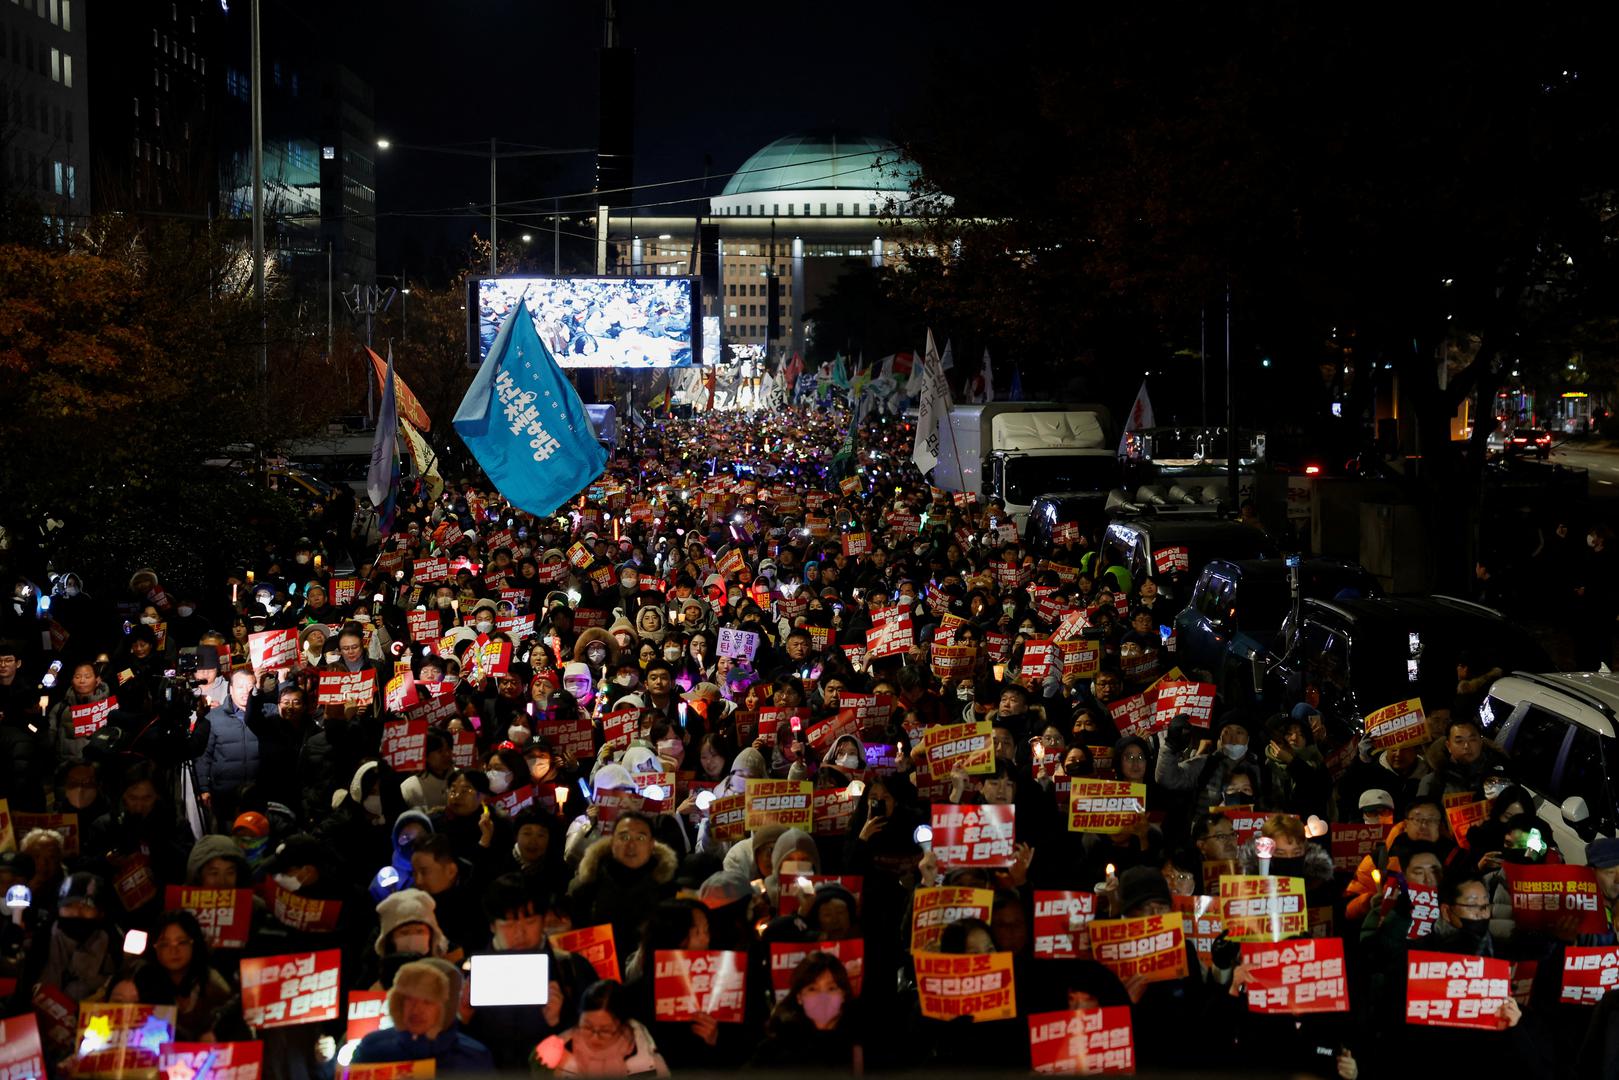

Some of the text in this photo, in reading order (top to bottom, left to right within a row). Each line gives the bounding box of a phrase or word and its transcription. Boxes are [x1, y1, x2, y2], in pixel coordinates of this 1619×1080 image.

[496, 366, 561, 462] 천촛불행동
[413, 620, 438, 632] 윤석열
[497, 615, 526, 628] 내란수괴
[812, 635, 828, 645] 석열
[934, 656, 970, 666] 국민의힘
[320, 668, 362, 685] 내란수괴
[840, 695, 877, 708] 내란수괴
[1158, 683, 1200, 699] 내란수괴
[72, 698, 109, 718] 내란수괴
[1110, 694, 1146, 719] 내란수괴
[1174, 696, 1213, 708] 윤석열
[1365, 701, 1409, 729] 내란동조
[538, 722, 578, 735] 내란수괴
[925, 723, 978, 747] 내란동조
[389, 734, 426, 751] 윤석열
[931, 737, 986, 759] 국민의힘
[394, 747, 425, 766] 탄핵!
[1073, 783, 1132, 796] 내란동조
[751, 795, 807, 811] 국민의힘
[1332, 824, 1384, 843] 내란수괴
[1222, 878, 1291, 898] 내란동조
[1513, 880, 1597, 893] 내란범죄자 윤석열
[181, 888, 237, 909] 내란죄
[914, 888, 975, 912] 내란동조
[1034, 894, 1093, 918] 내란수괴
[1514, 893, 1598, 912] 대통령 아님
[916, 906, 982, 929] 국민의힘
[1090, 916, 1164, 943] 내란동조
[1034, 933, 1074, 954] 즉각
[1102, 931, 1175, 961] 국민의힘
[916, 955, 992, 974] 내란동조
[1108, 951, 1183, 980] 체하라!
[1281, 957, 1343, 985] 윤석열
[1408, 957, 1485, 980] 내란수괴
[280, 967, 339, 1000] 윤석열
[924, 971, 1004, 996] 국민의힘
[1248, 976, 1345, 1009] 즉각 탄핵!
[1446, 978, 1509, 999] 윤석열
[1561, 986, 1606, 1001] 즉각
[289, 985, 338, 1017] 탄핵!
[925, 989, 1011, 1016] 해체하라!
[1406, 1000, 1453, 1020] 즉각
[1031, 1008, 1104, 1044] 내란수괴
[1068, 1026, 1131, 1057] 윤석열
[1084, 1047, 1132, 1075] 탄핵!
